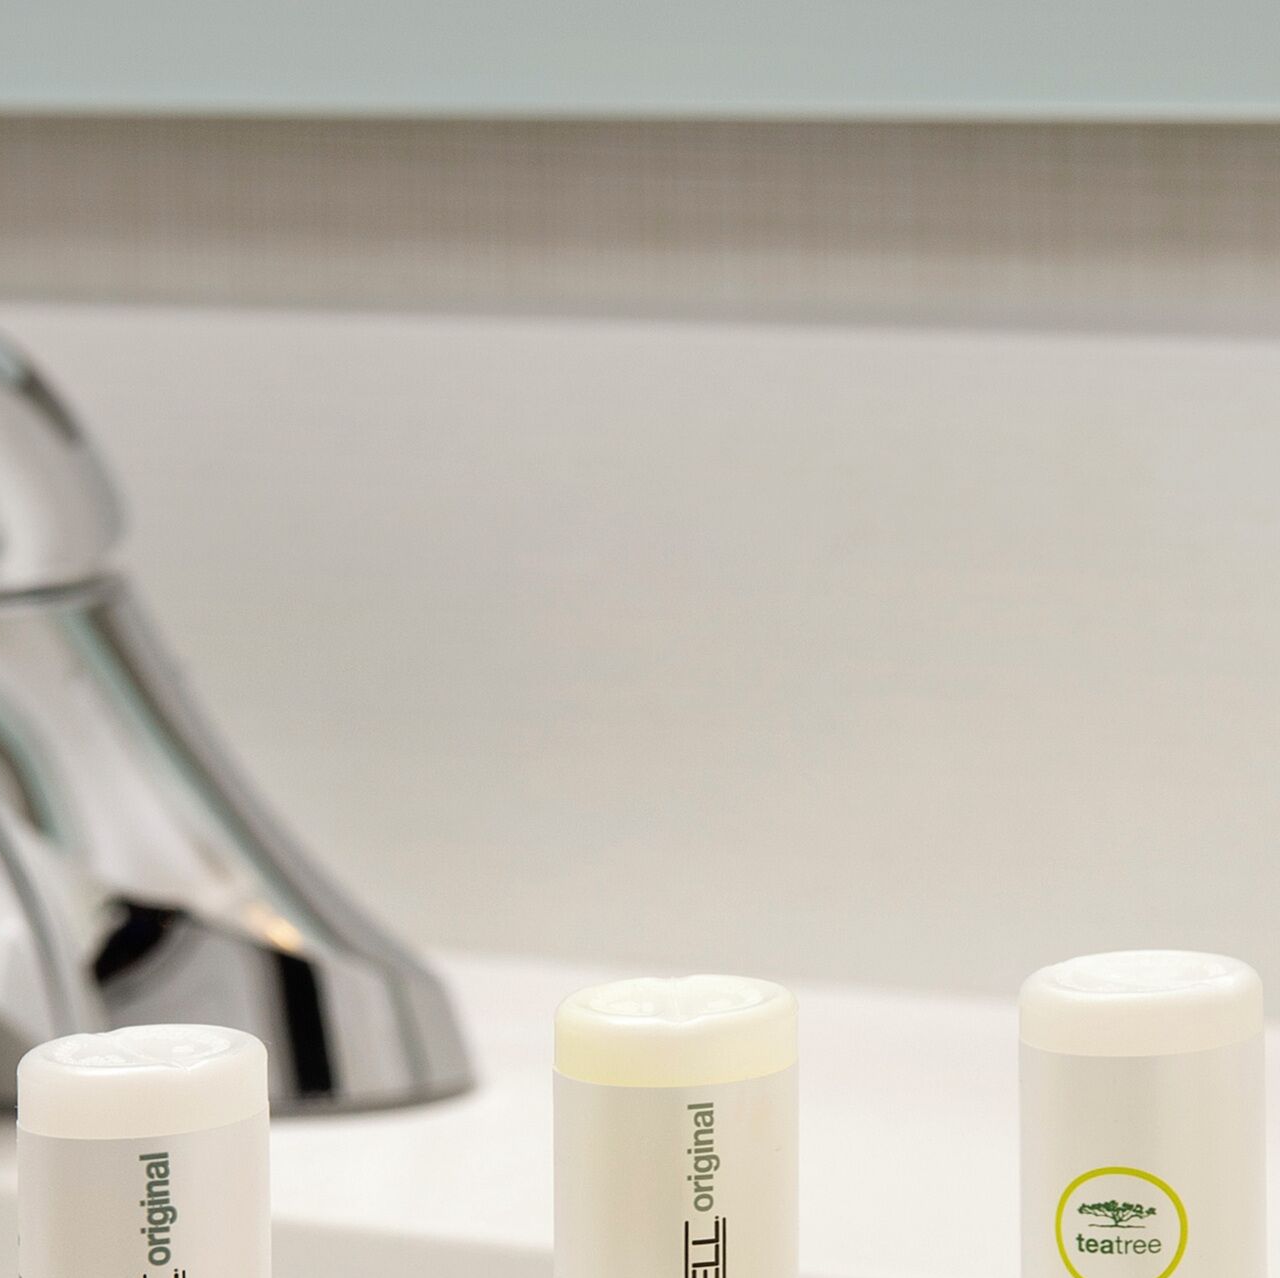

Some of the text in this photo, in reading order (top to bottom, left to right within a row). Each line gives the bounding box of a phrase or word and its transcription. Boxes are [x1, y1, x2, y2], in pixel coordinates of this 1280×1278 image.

[139, 1152, 177, 1266] original
[687, 1102, 720, 1212] original
[1076, 1234, 1161, 1254] teatree
